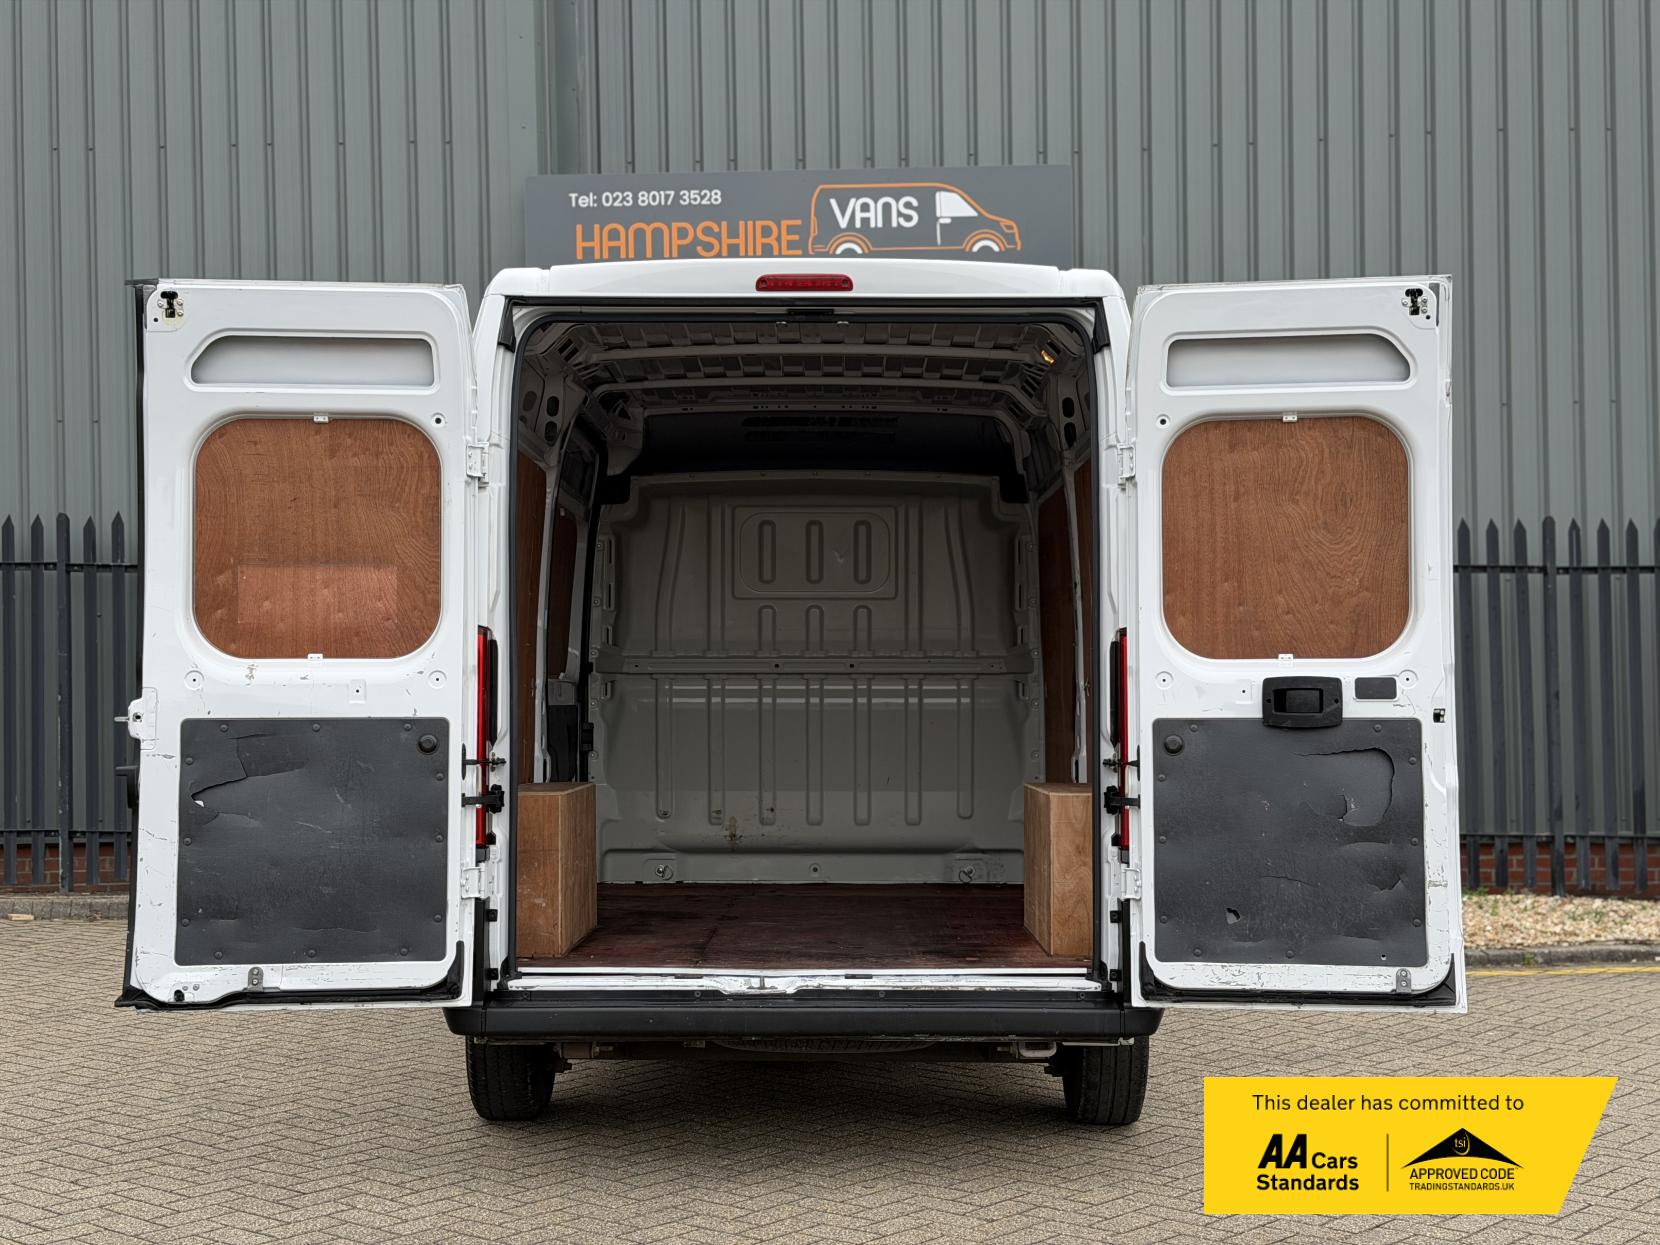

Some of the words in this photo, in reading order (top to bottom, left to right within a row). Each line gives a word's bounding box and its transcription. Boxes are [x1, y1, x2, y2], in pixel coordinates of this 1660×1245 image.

[569, 192, 597, 208] Tel:
[602, 191, 633, 207] 023
[638, 191, 675, 207] 8017
[679, 189, 722, 206] 3528
[575, 219, 803, 260] HAMPSHIRE
[829, 195, 919, 229] VANS
